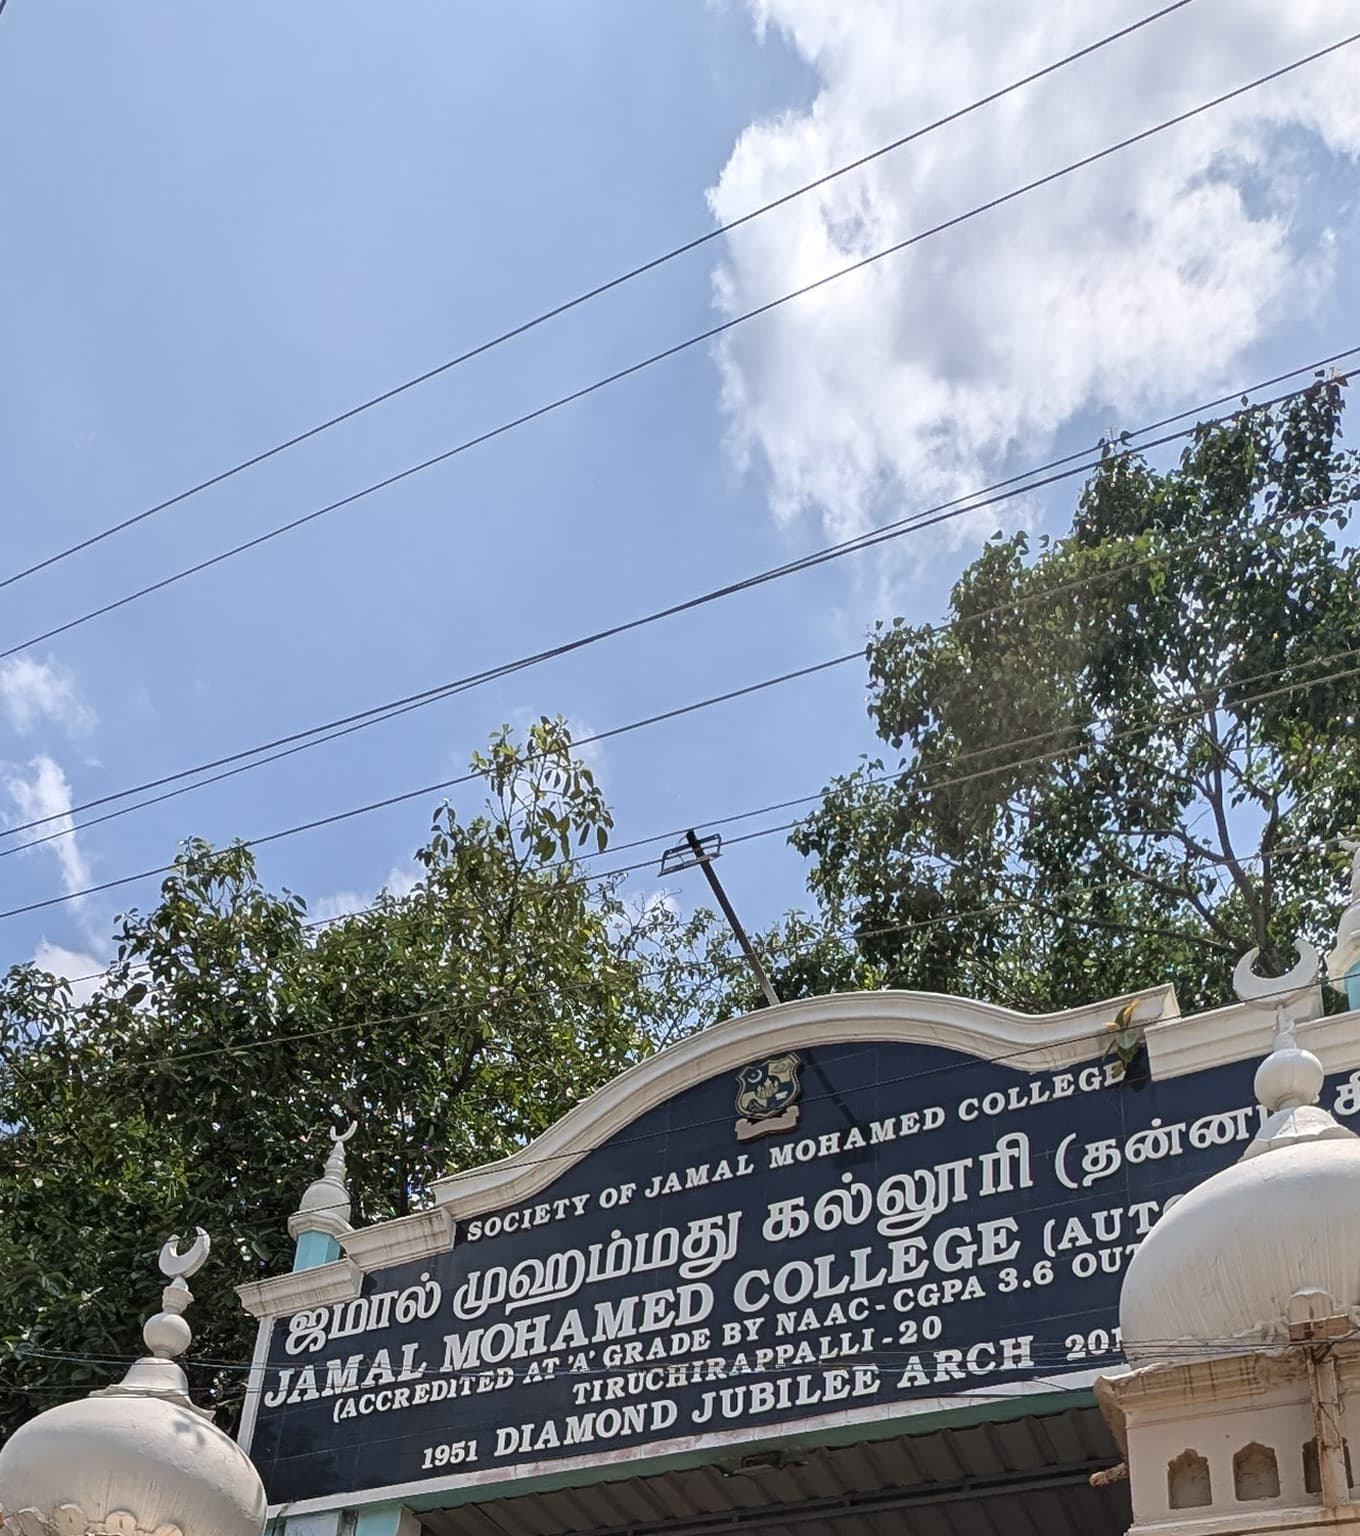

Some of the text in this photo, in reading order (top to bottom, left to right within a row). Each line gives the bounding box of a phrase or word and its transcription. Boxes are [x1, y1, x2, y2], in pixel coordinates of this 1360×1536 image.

[467, 1061, 1127, 1242] SOCIETY OF JAMAL MOHAMED COLLEGE
[264, 1342, 428, 1409] JAMAL
[440, 1282, 714, 1373] MOHAMED
[734, 1216, 1021, 1312] COLLEGE
[285, 1272, 441, 1355] ஜமால்
[453, 1211, 742, 1321] முஹம்மது
[762, 1132, 1033, 1242] கல்லூரி
[333, 1367, 514, 1423] (ACCREDITED
[523, 1355, 560, 1385] AT
[602, 1328, 711, 1368] GRADE
[722, 1318, 765, 1346] BY
[997, 1260, 1054, 1293] 3.6
[421, 1327, 1123, 1470] 1951 DIAMOND JUBILEE ARCH 201
